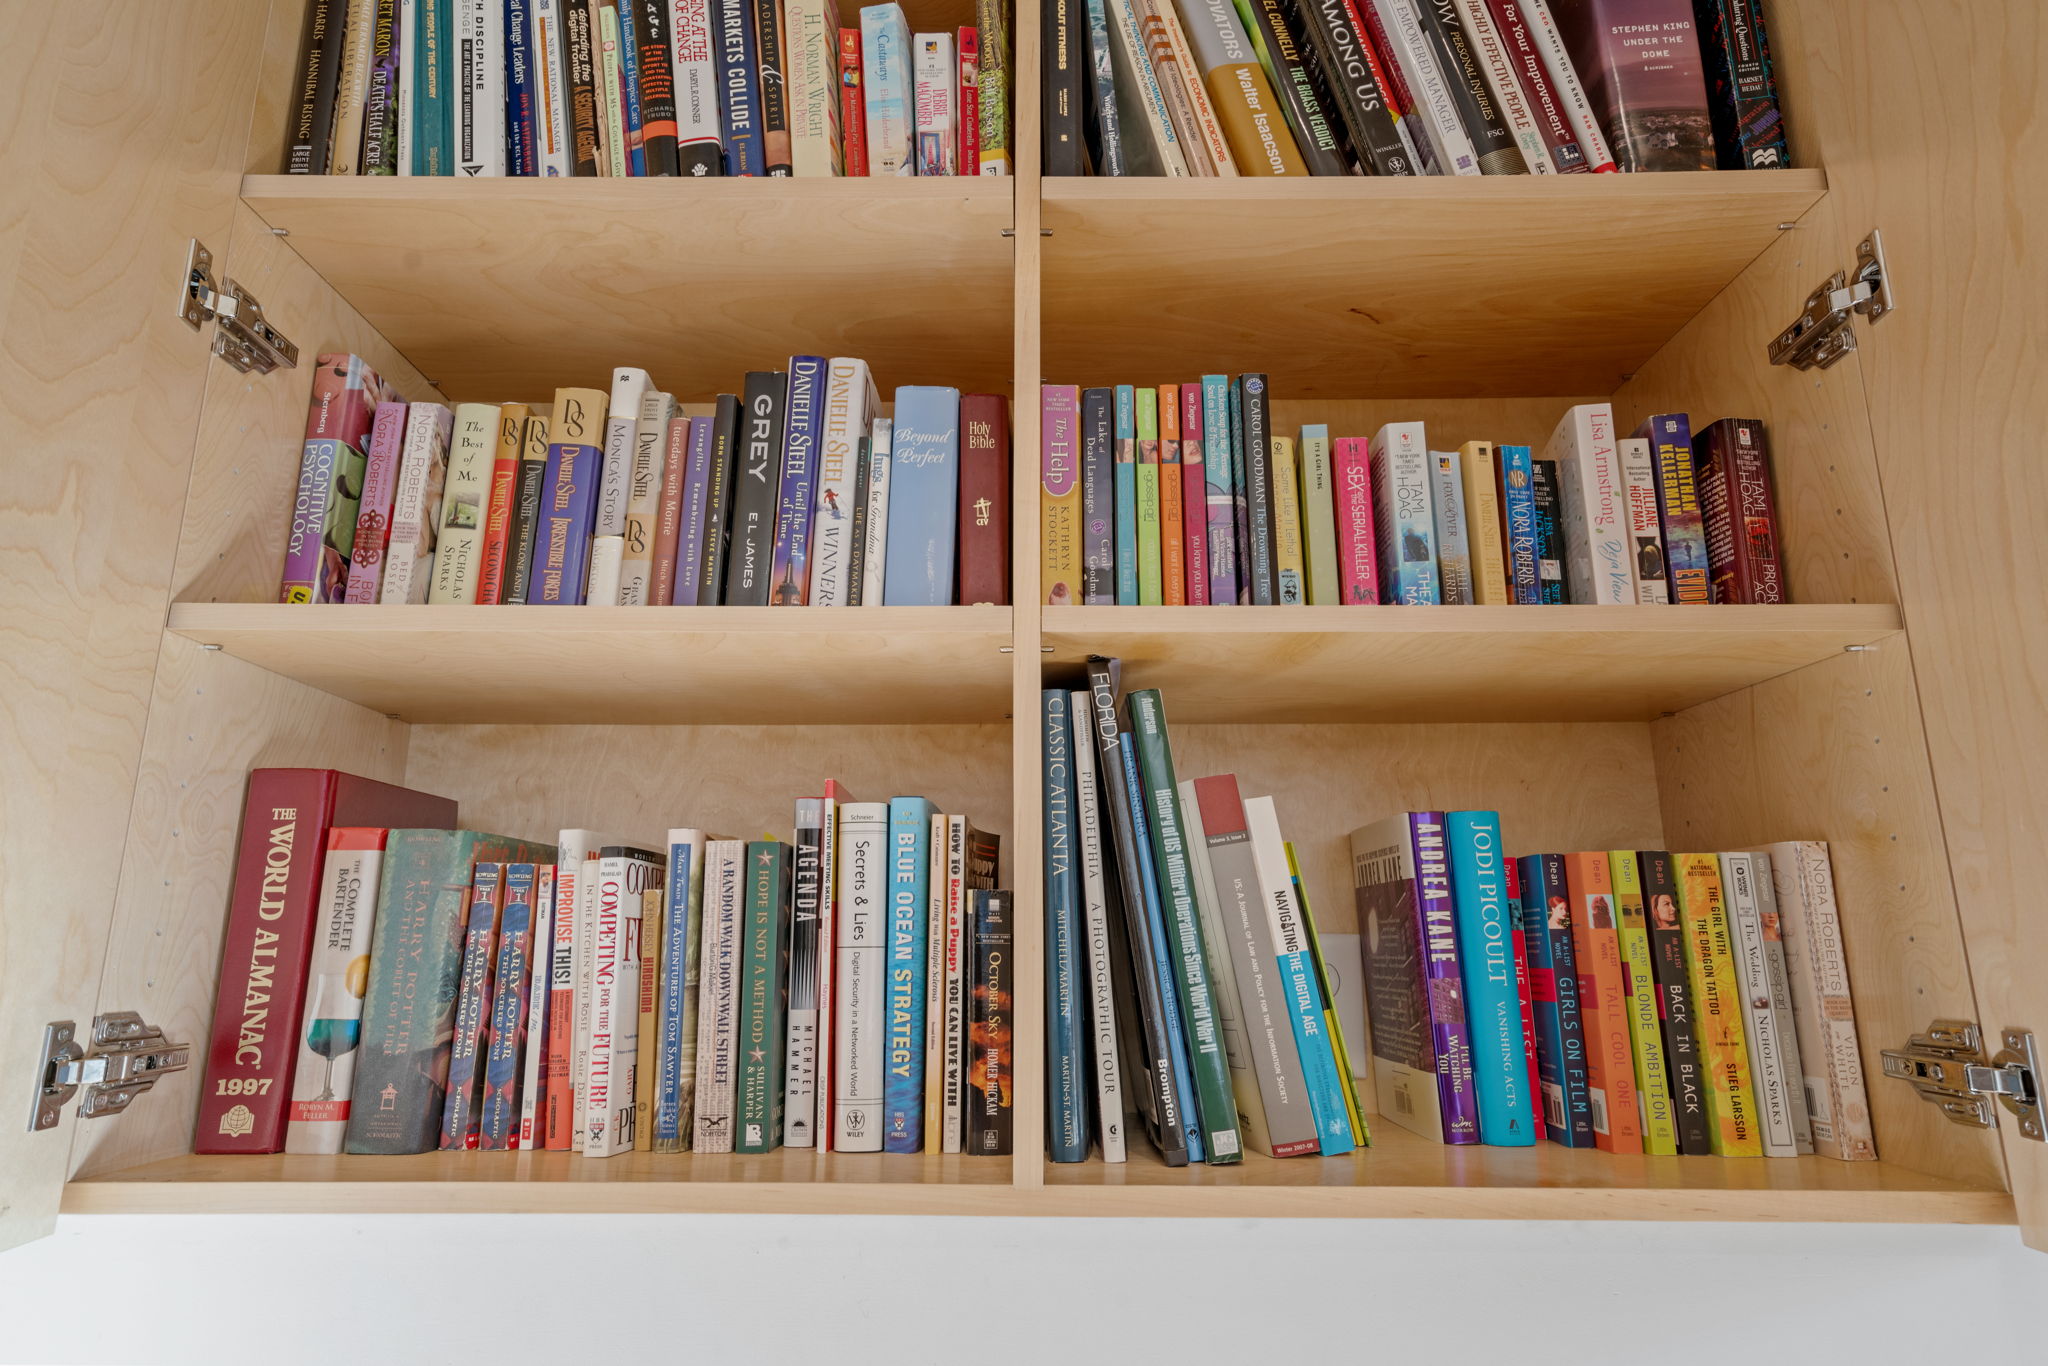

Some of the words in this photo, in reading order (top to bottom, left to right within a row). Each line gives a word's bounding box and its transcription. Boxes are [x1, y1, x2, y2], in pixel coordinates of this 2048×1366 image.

[375, 22, 393, 56] MARON
[510, 15, 522, 49] Change
[568, 10, 578, 42] digital
[579, 8, 589, 61] defending
[676, 15, 692, 64] CHANGE
[723, 0, 744, 63] MARKETS
[1268, 13, 1300, 61] CONNELLY
[1612, 23, 1659, 34] STEPHEN
[1663, 21, 1690, 31] KING
[1623, 38, 1658, 47] UNDER
[304, 50, 321, 101] HANNIBAL
[476, 18, 484, 90] DISCIPLINE
[514, 47, 525, 85] Leaders
[571, 43, 580, 84] frontier
[582, 63, 590, 82] the
[1290, 66, 1308, 83] THE
[1321, 0, 1366, 78] AMONG
[1356, 83, 1380, 111] US
[1396, 6, 1433, 75] EMPOWERED
[1425, 77, 1457, 134] MANAGER
[1450, 31, 1477, 80] PERSONAL
[1471, 79, 1495, 121] INJURIES
[1466, 1, 1491, 35] HIGHLY
[1481, 37, 1514, 90] EFFECTIVE
[1503, 90, 1531, 130] PEOPLE
[1642, 50, 1670, 58] DOME
[728, 68, 750, 131] COLLIDE
[985, 77, 995, 96] Bill
[1296, 84, 1320, 113] BRASS
[1738, 75, 1763, 83] BARNET
[300, 103, 313, 139] RISING
[916, 81, 932, 127] MACOMBER
[933, 88, 947, 117] DEBBIE
[985, 100, 996, 137] Bryson
[1235, 68, 1262, 111] Walter
[1253, 112, 1285, 174] Isaacson
[1308, 113, 1336, 151] VERDICT
[1486, 128, 1504, 138] FSG
[316, 392, 332, 434] Sternberg
[415, 413, 432, 453] NORA
[464, 420, 484, 433] The
[969, 420, 991, 441] Holy
[1054, 417, 1067, 439] The
[1250, 399, 1262, 437] CAROL
[1589, 413, 1608, 441] Lisa
[461, 437, 484, 448] Best
[606, 424, 627, 484] MONICA'S
[667, 426, 682, 470] tuesdays
[717, 435, 725, 453] BORN
[748, 394, 773, 484] GREY
[969, 434, 995, 449] Bible
[1086, 437, 1096, 461] Dead
[456, 470, 478, 482] Me
[665, 473, 677, 496] with
[714, 456, 725, 493] STANDING
[1046, 441, 1070, 485] Help
[1253, 438, 1266, 503] GOODMAN
[1346, 465, 1364, 490] SEX
[1659, 444, 1682, 516] KELLERMAN
[1674, 447, 1697, 511] JONATHAN
[289, 444, 318, 557] PSYCHOLOGY
[312, 443, 333, 535] COGNITIVE
[403, 455, 426, 520] ROBERTS
[601, 485, 620, 529] STORY
[712, 495, 719, 508] UP
[1085, 464, 1097, 514] Languages
[1396, 476, 1412, 520] HOAG
[1411, 481, 1425, 514] TAMI
[1591, 446, 1617, 526] Armstrong
[662, 499, 677, 536] Morrie
[1256, 508, 1266, 524] The
[1351, 505, 1368, 542] SERIAL
[1511, 501, 1531, 532] NORA
[1629, 485, 1646, 532] HOFFMAN
[1048, 505, 1058, 571] STOCKETT
[1060, 506, 1070, 571] KATHRYN
[1258, 528, 1268, 574] Drowning
[1514, 534, 1535, 586] ROBERTS
[439, 545, 455, 591] SPARKS
[452, 538, 472, 600] NICHOLAS
[706, 557, 715, 586] MARTIN
[1353, 544, 1370, 580] KILLER
[1261, 576, 1270, 598] Tree
[1092, 672, 1120, 752] FLORIDA
[1048, 697, 1066, 778] CLASSIC
[272, 807, 297, 821] THE
[825, 813, 833, 851] EFFECTIVE
[850, 813, 875, 821] Schneier
[1050, 785, 1069, 877] ATLANTA
[1081, 771, 1100, 879] PHILADELPHIA
[259, 821, 296, 922] WORLD
[895, 833, 916, 883] BLUE
[1416, 822, 1447, 900] ANDREA
[1470, 821, 1496, 879] JODI
[757, 870, 771, 903] HOPE
[795, 843, 817, 923] AGENDA
[1708, 886, 1718, 905] THE
[326, 867, 350, 950] BARTENDER
[556, 874, 575, 945] IMPROVISE
[757, 907, 769, 923] IS
[894, 890, 916, 961] OCEAN
[1696, 918, 1707, 938] THE
[1710, 906, 1721, 931] GIRL
[1810, 858, 1828, 907] NORA
[1819, 911, 1842, 993] ROBERTS
[595, 881, 619, 986] COMPETING
[755, 926, 768, 961] NOT
[1426, 910, 1456, 963] KANE
[1479, 883, 1509, 987] PICOULT
[1715, 932, 1727, 956] WITH
[553, 946, 572, 985] THIS!
[755, 966, 765, 977] A
[1700, 940, 1714, 977] DRAGON
[235, 927, 280, 1066] ALMANAC
[599, 987, 612, 1006] FOR
[987, 950, 1002, 1012] OCTOBER
[1091, 917, 1113, 1045] PHOTOGRAPHIC
[1292, 966, 1314, 1010] DIGITAL
[1558, 976, 1578, 1030] GIRLS
[1635, 974, 1655, 1031] BLONDE
[1708, 978, 1721, 1016] TATTOO
[598, 1006, 610, 1031] THE
[752, 981, 766, 1045] METHOD
[892, 968, 914, 1078] STRATEGY
[1302, 1010, 1319, 1037] AGE
[1668, 984, 1686, 1024] BACK
[987, 1013, 1002, 1041] SKY
[1496, 999, 1513, 1072] VANISHING
[1676, 1034, 1691, 1053] IN
[789, 1024, 800, 1096] HAMMER
[802, 1024, 813, 1096] MICHAEL
[1566, 1038, 1581, 1061] ON
[215, 1078, 273, 1097] 1997
[588, 1033, 611, 1111] FUTURE
[755, 1066, 765, 1120] SULLIVAN
[1101, 1049, 1116, 1096] TOUR
[1157, 1058, 1175, 1128] Brompton
[1505, 1073, 1517, 1109] ACTS
[1568, 1068, 1587, 1113] FILM
[1644, 1041, 1667, 1121] AMBITION
[1680, 1063, 1699, 1114] BLACK
[1725, 1062, 1738, 1091] STIEG
[298, 1102, 324, 1111] ROBYN
[744, 1075, 756, 1120] HARPER
[1730, 1092, 1748, 1141] LARSSON
[846, 1130, 865, 1138] WILEY
